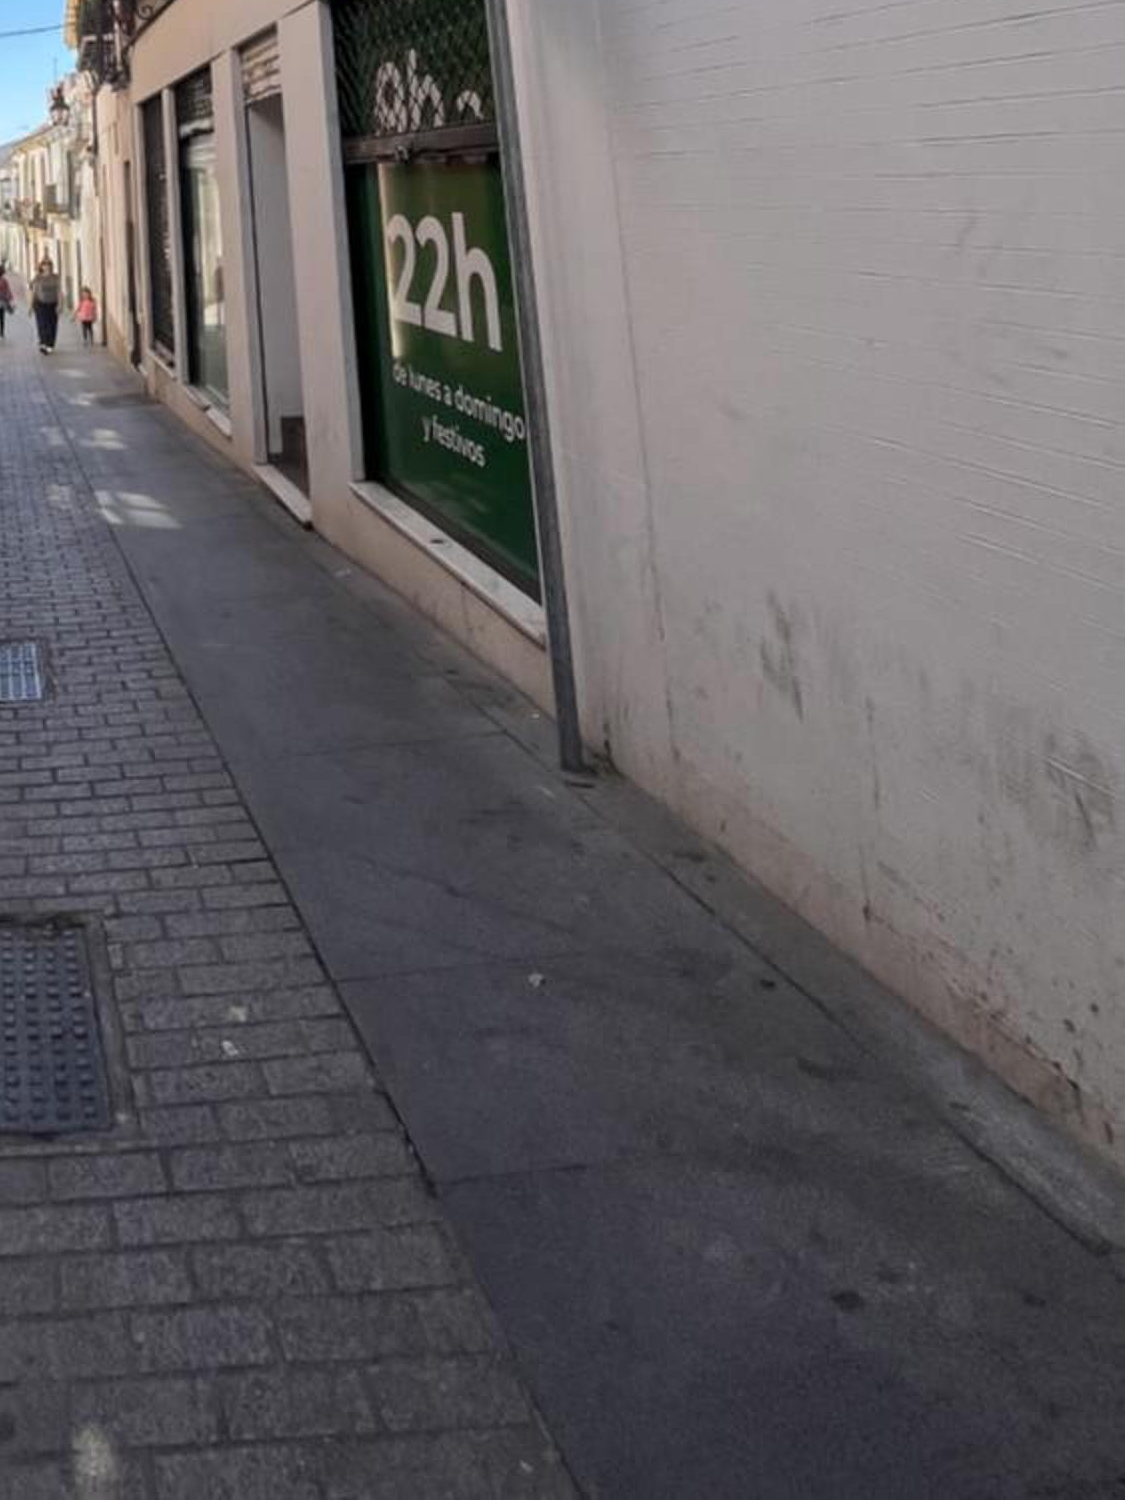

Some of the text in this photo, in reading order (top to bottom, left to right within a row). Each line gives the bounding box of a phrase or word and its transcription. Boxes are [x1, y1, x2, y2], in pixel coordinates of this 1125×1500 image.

[386, 211, 503, 352] 22h
[392, 360, 525, 442] de lunes a domingo
[421, 414, 486, 468] y festivos
